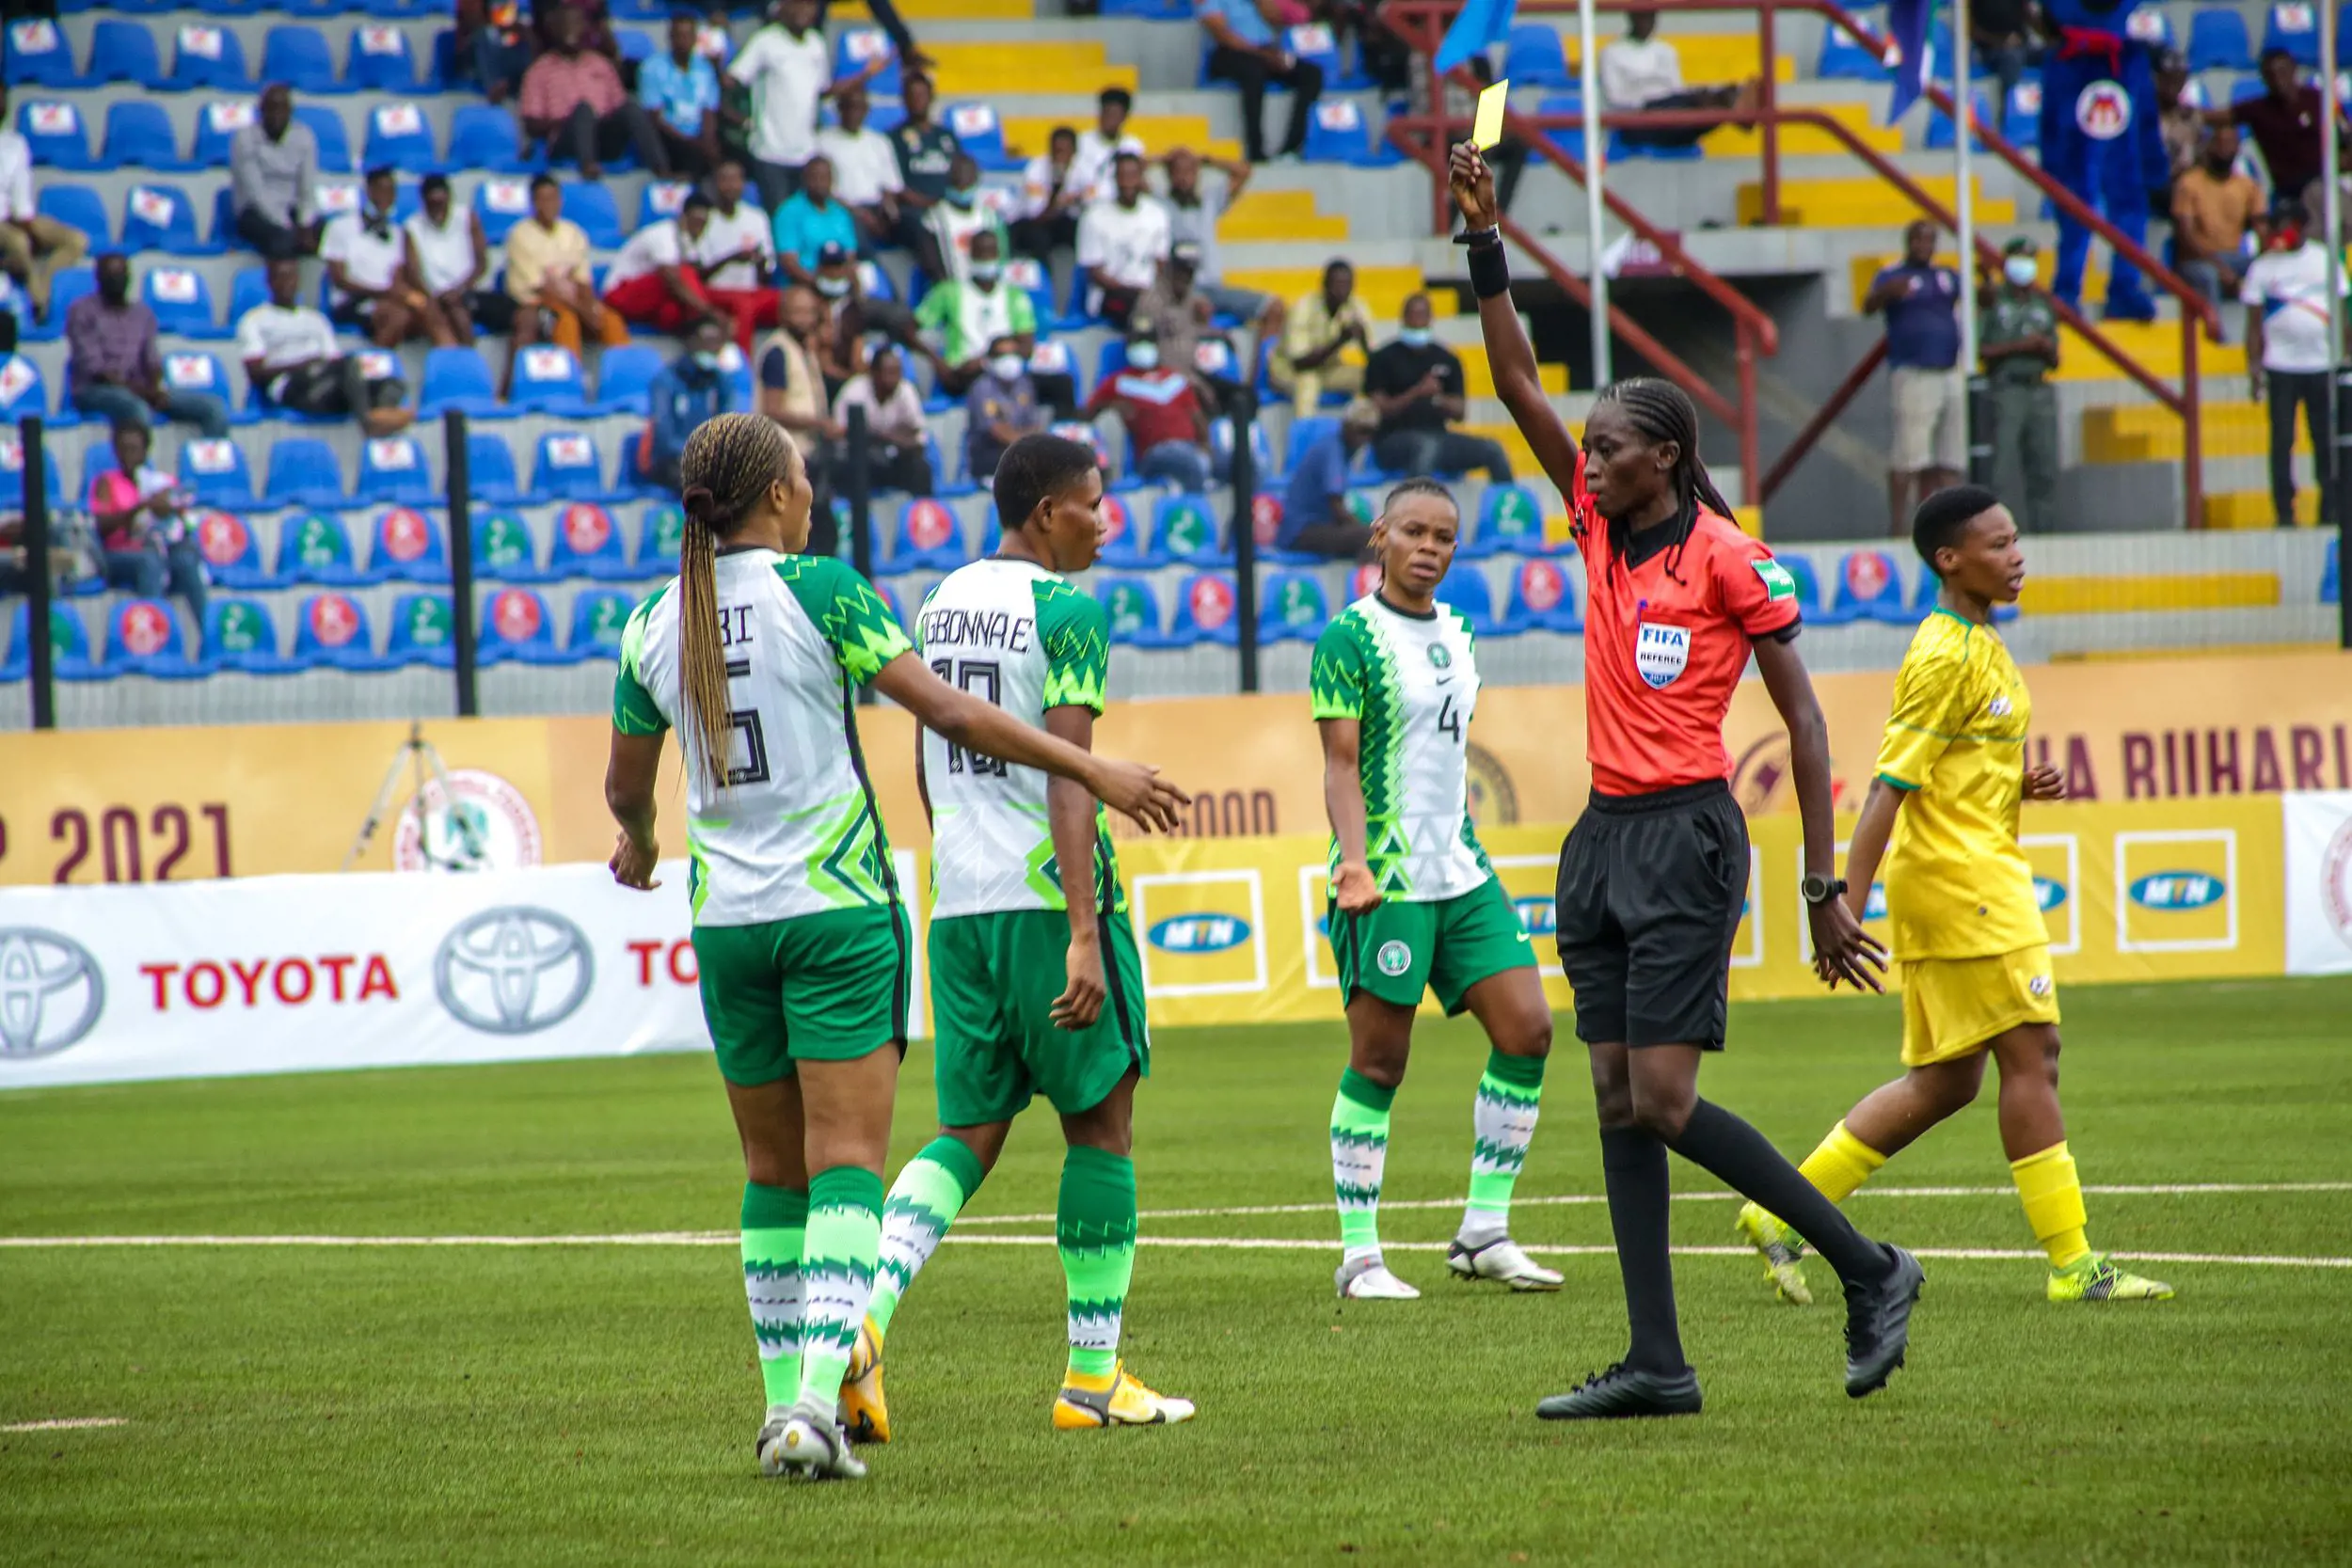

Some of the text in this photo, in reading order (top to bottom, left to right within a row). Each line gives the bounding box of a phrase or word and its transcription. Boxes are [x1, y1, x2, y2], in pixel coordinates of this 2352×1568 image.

[1643, 627, 1684, 647] FIFA
[1640, 651, 1682, 665] REFEREE
[1438, 693, 1460, 744] 4
[51, 804, 230, 883] 2021
[2142, 876, 2211, 905] MTN
[1163, 918, 1235, 948] MTN
[139, 953, 400, 1011] TOYOTA
